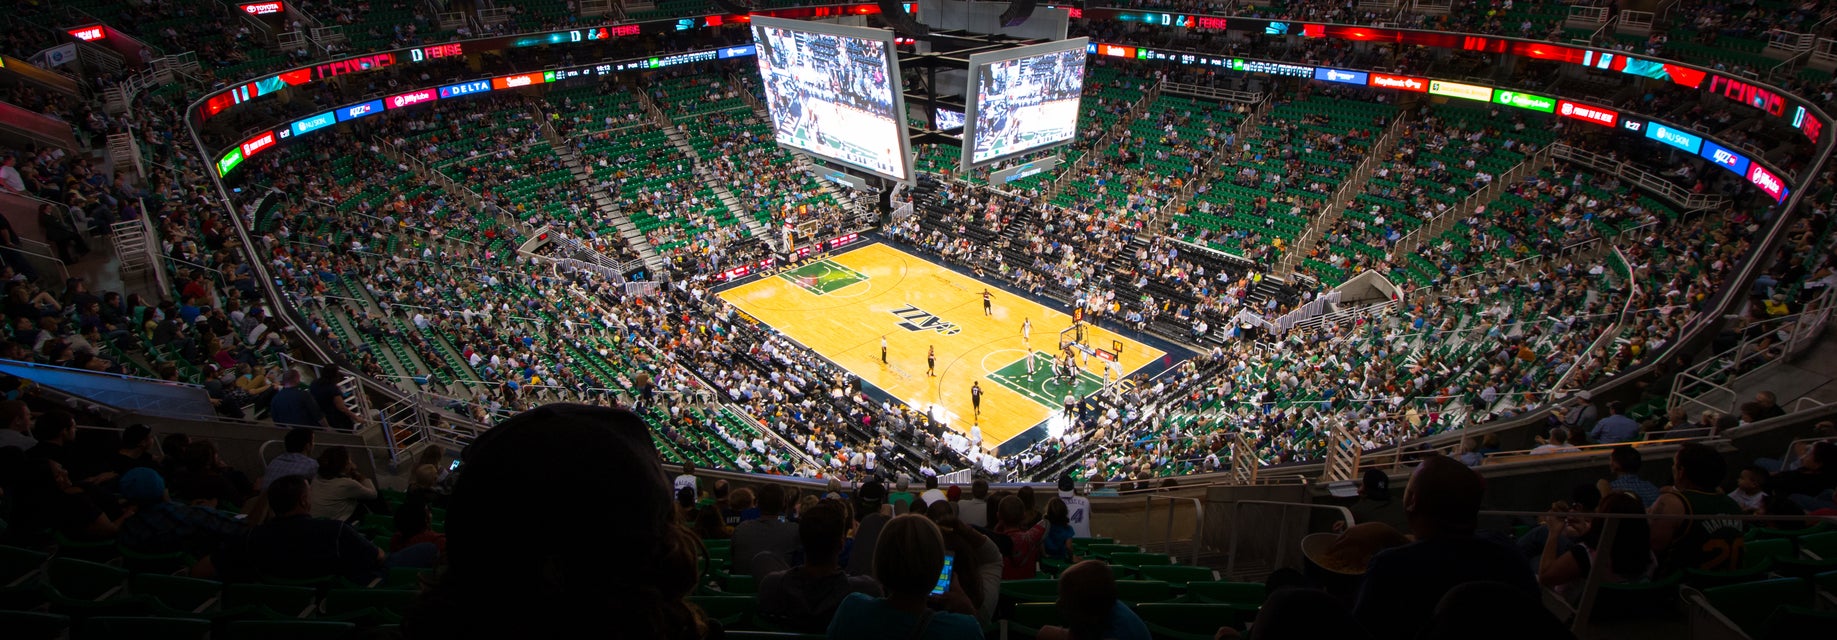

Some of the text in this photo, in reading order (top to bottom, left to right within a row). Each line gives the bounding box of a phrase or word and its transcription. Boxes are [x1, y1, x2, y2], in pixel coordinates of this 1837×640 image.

[1162, 13, 1171, 26] D
[424, 43, 463, 60] FENSE
[451, 81, 489, 95] DELTA
[1071, 508, 1083, 523] 4
